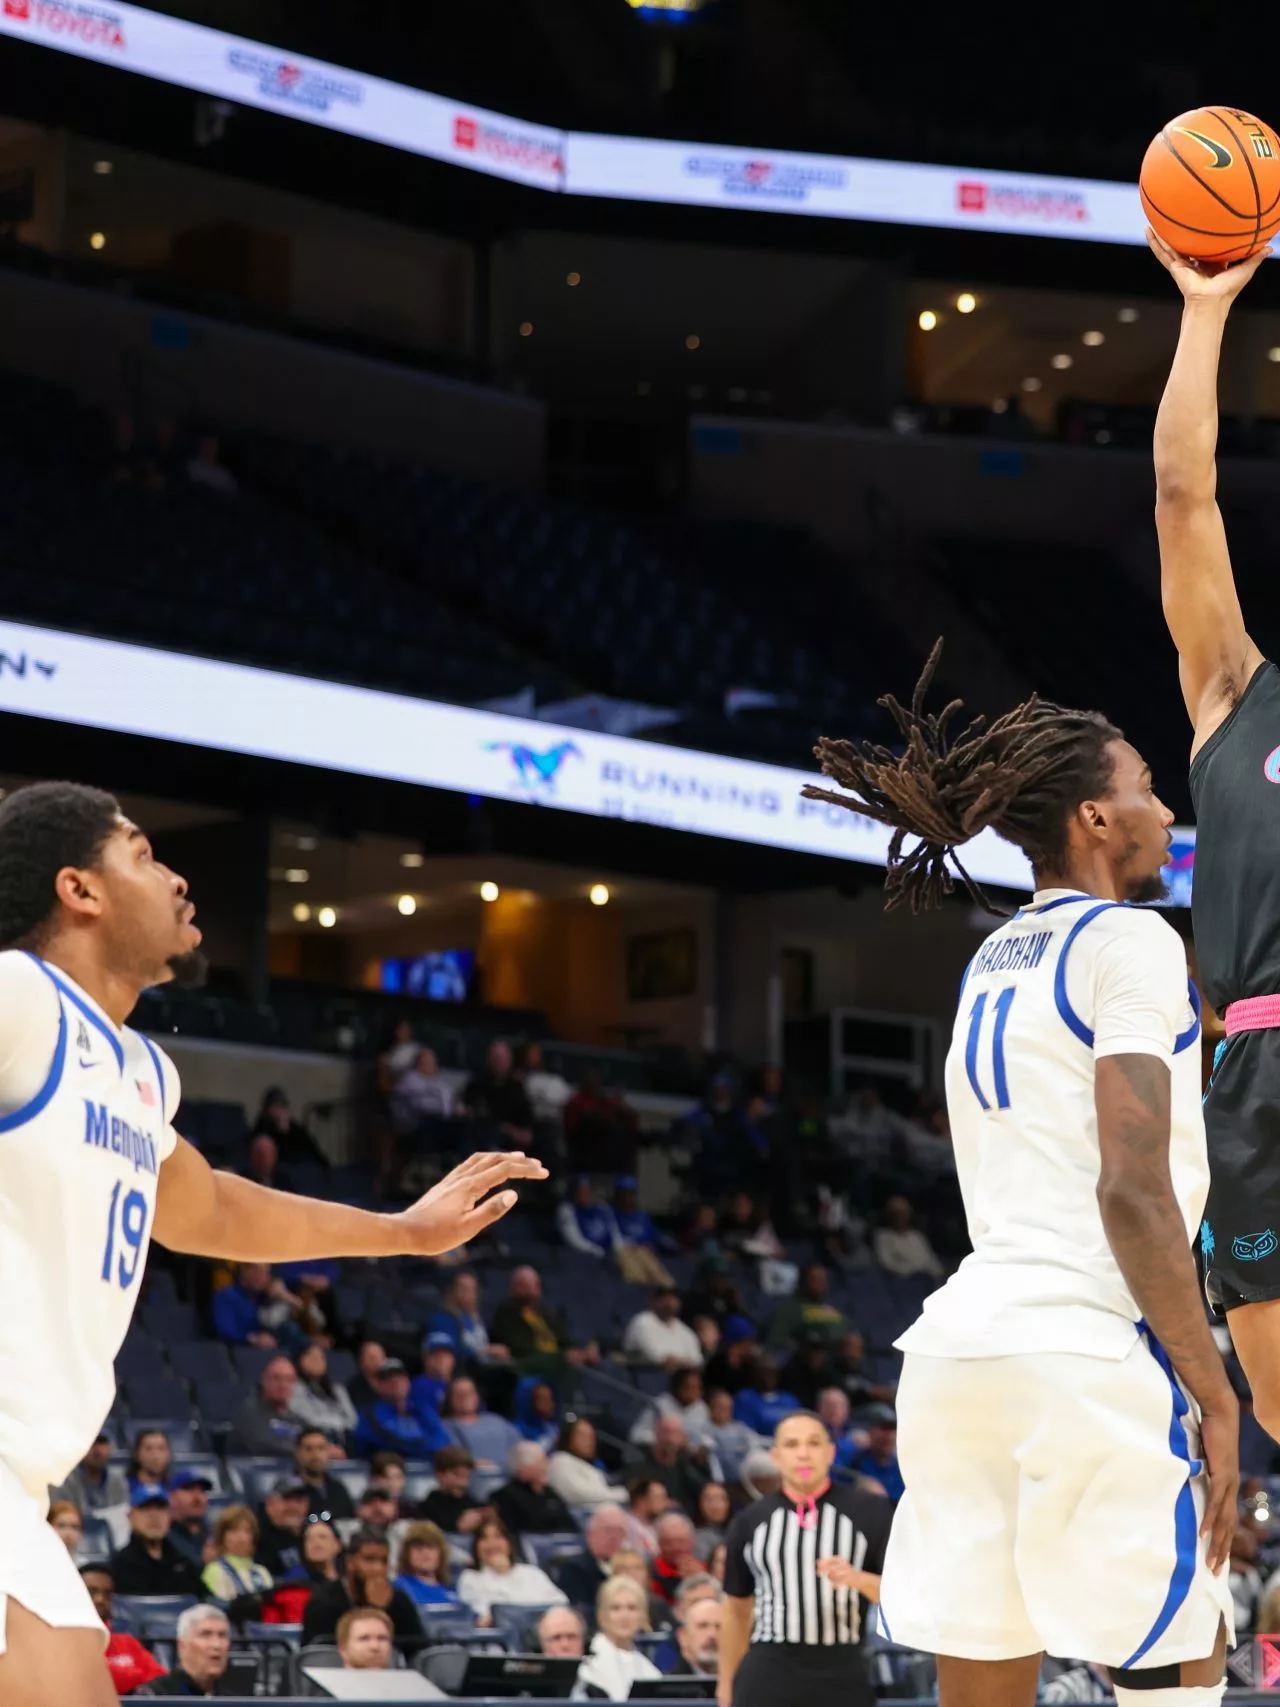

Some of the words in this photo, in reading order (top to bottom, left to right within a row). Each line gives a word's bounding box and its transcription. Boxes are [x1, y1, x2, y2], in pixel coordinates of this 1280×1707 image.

[965, 985, 1016, 1111] 11
[84, 1098, 158, 1176] Memphi
[101, 1179, 148, 1291] 19
